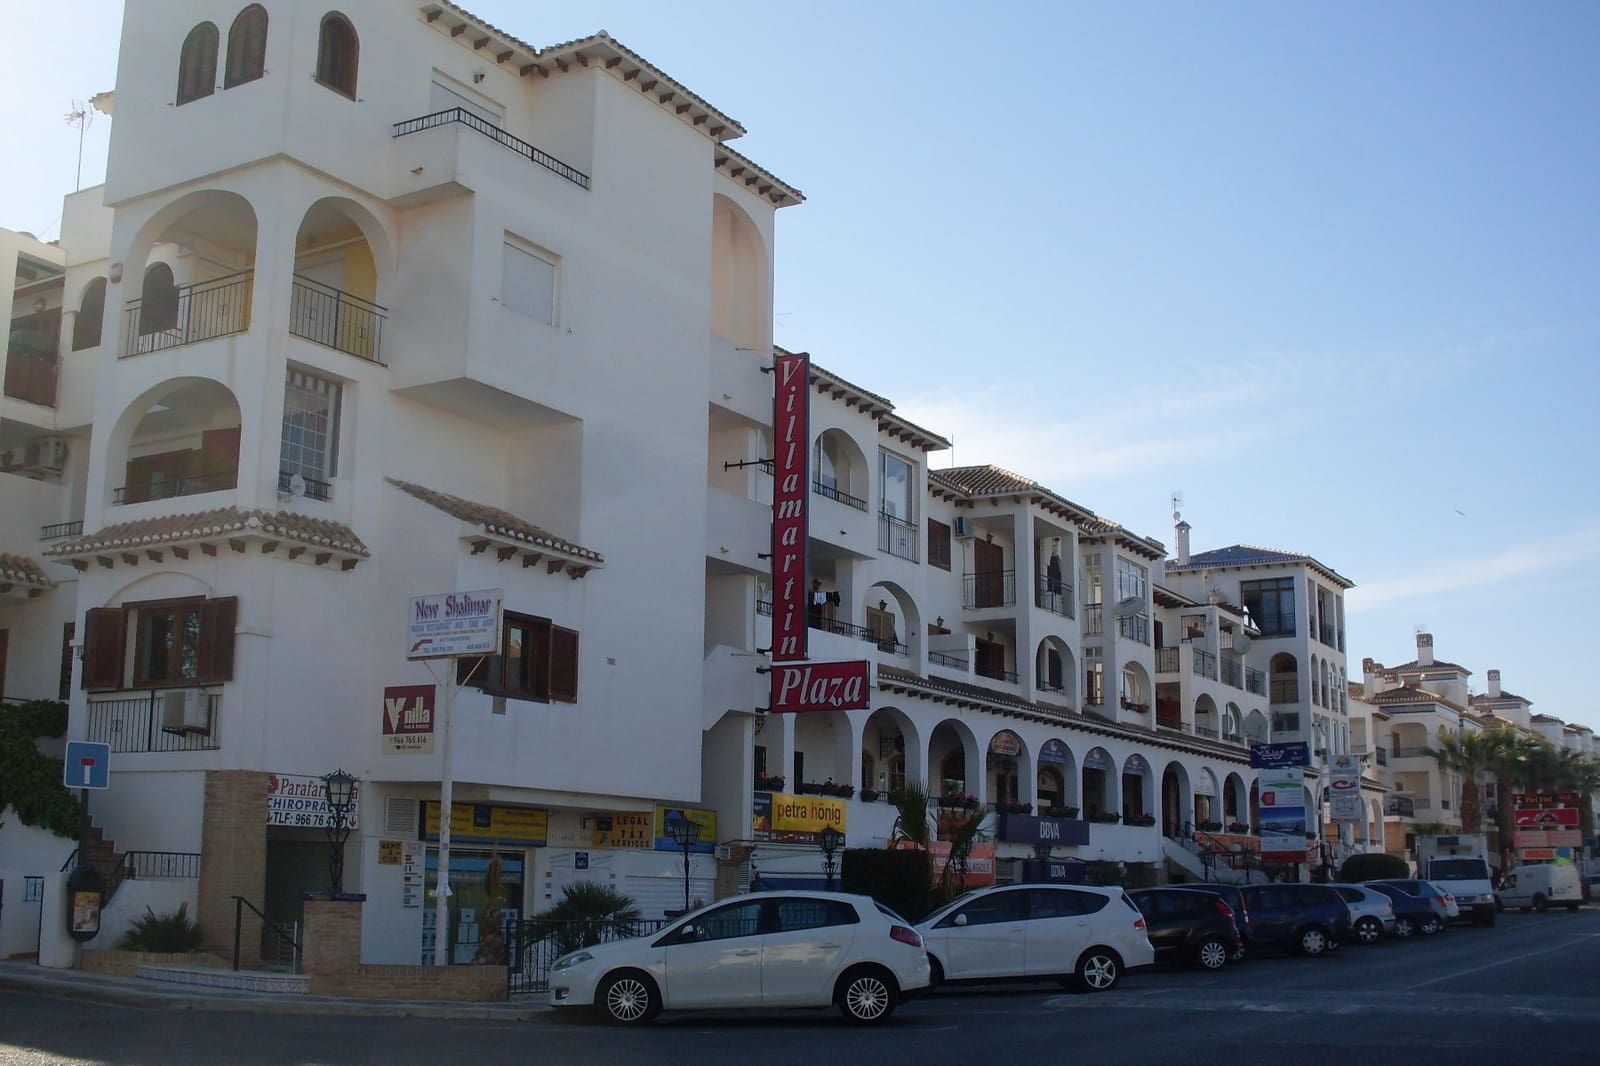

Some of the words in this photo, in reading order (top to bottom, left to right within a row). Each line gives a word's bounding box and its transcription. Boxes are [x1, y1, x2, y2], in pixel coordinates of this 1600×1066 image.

[778, 358, 803, 655] Villamartin
[415, 600, 438, 620] New
[445, 595, 491, 618] Shalimar
[776, 667, 862, 707] Plaza
[267, 798, 356, 814] CHIROPRACOR
[777, 801, 807, 821] petra
[811, 802, 841, 825] hönig
[274, 812, 293, 824] TLF:
[295, 814, 311, 825] 966
[313, 815, 324, 826] 76
[617, 816, 649, 825] LEGAL
[621, 830, 645, 839] TAX
[1040, 821, 1060, 840] BBVA
[1050, 864, 1066, 878] BBVA
